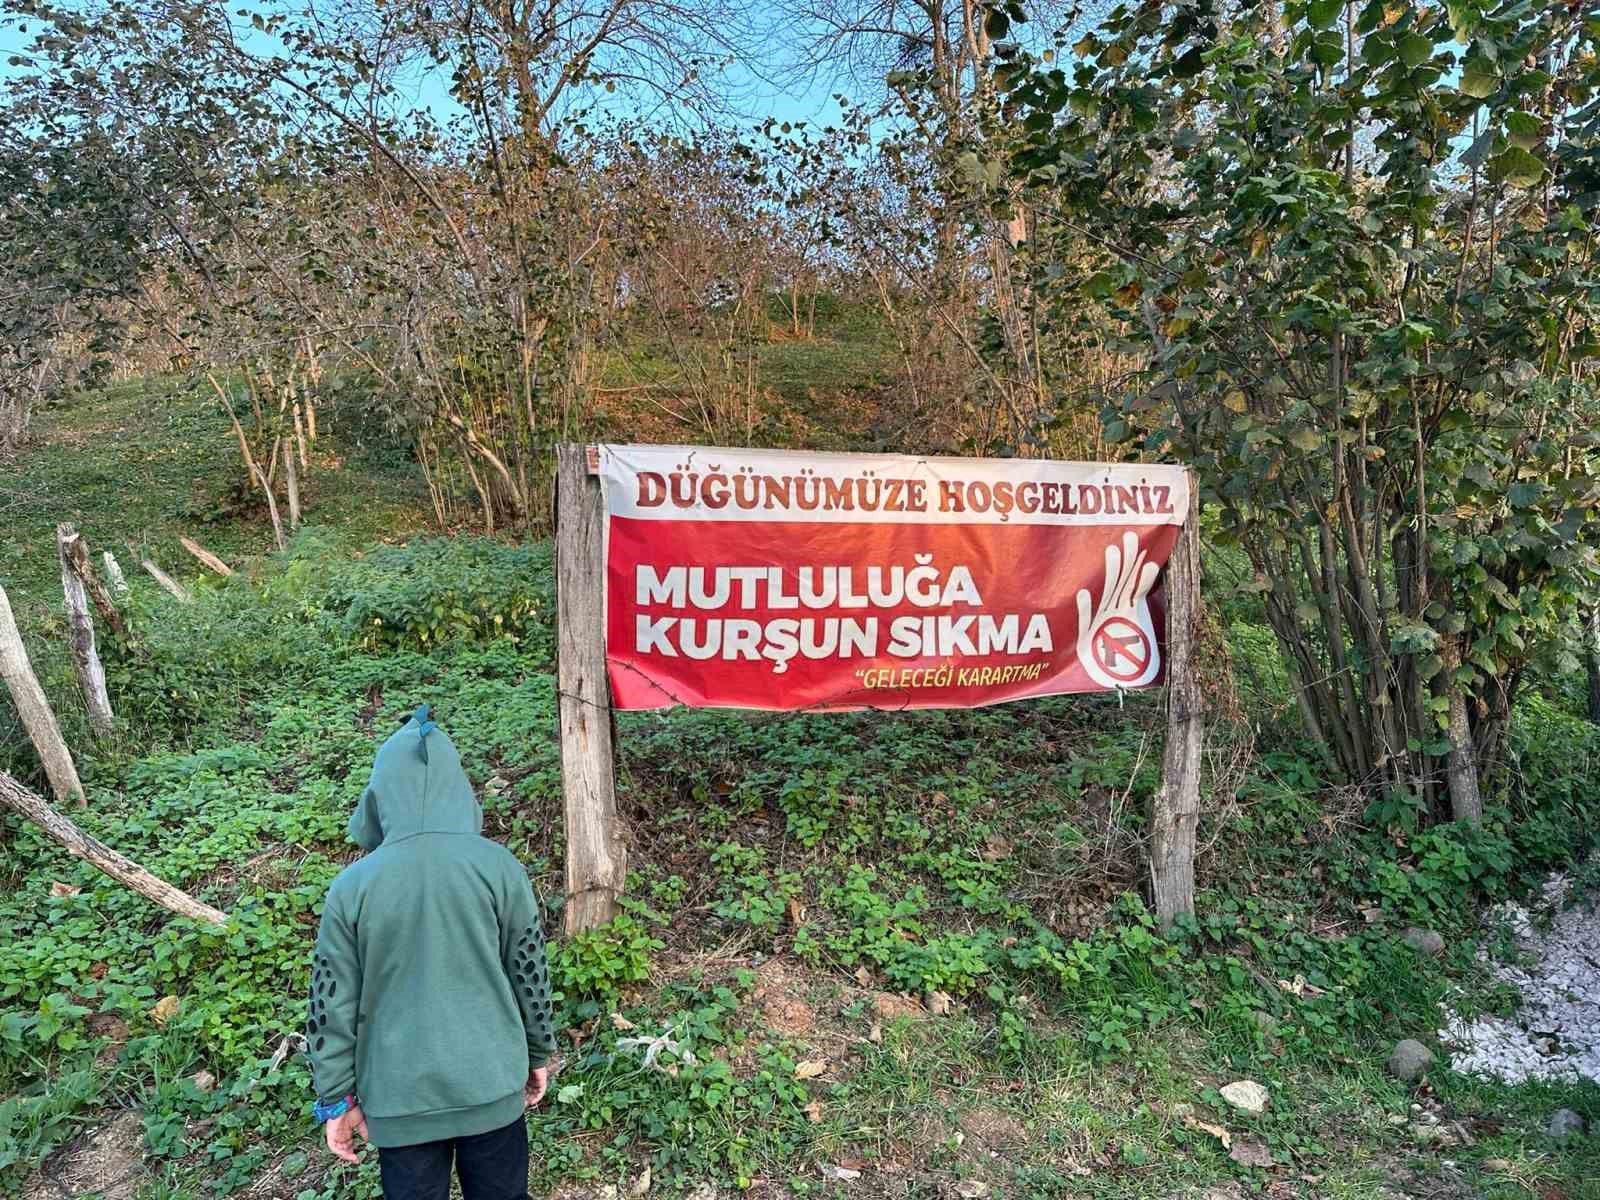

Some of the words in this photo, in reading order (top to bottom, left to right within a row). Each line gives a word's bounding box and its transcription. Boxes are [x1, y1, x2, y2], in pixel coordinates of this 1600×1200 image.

[636, 463, 927, 512] DÜĞÜNÜMÜZE
[939, 477, 1174, 521] HOŞGELDİNİZ
[636, 553, 983, 610] MUTLULUĞA
[636, 614, 878, 673] KURŞUN
[887, 615, 1053, 657] SIKMA
